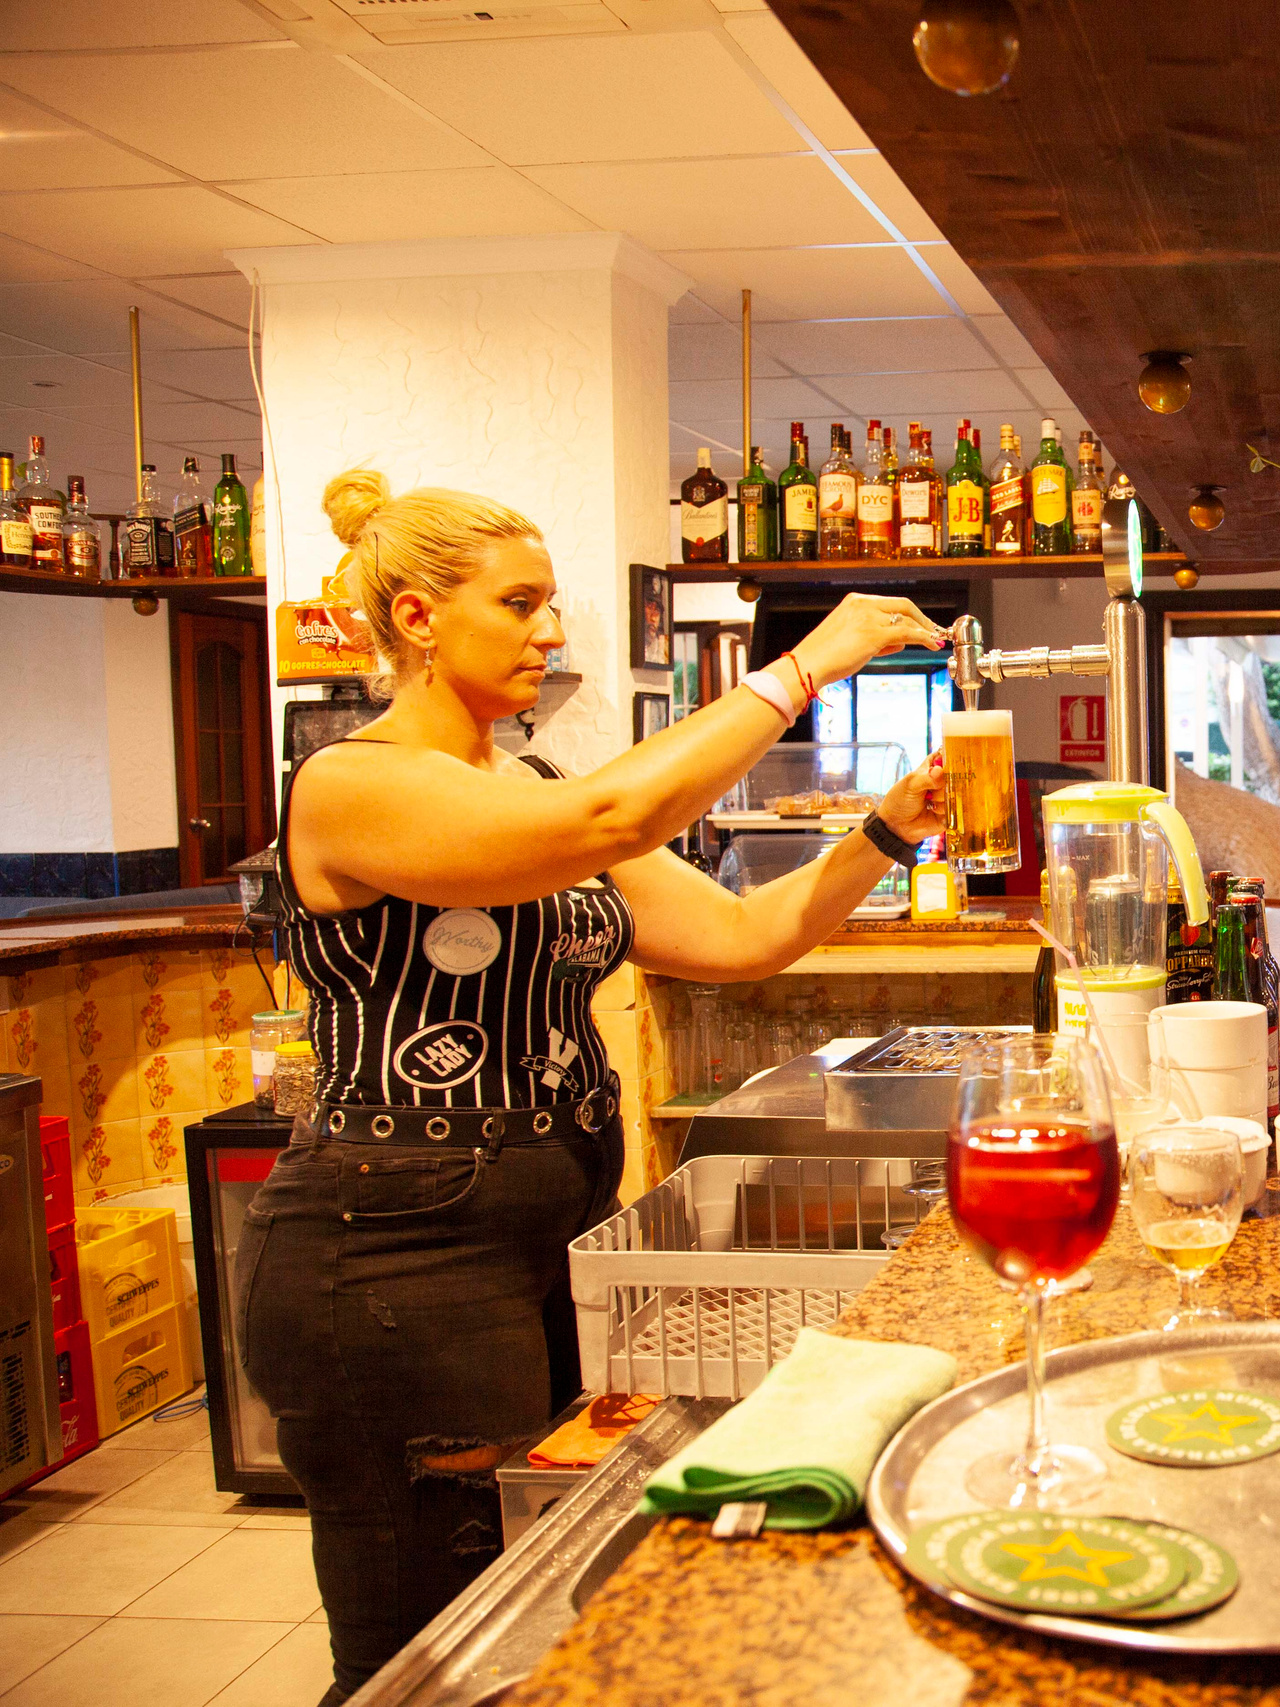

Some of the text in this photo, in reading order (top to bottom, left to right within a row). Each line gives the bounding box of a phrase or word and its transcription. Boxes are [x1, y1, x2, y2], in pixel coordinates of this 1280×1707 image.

[791, 488, 817, 498] JAMES
[861, 494, 889, 506] DYC
[992, 486, 1022, 500] RED LABEL
[35, 511, 62, 520] SOUTHE
[38, 519, 63, 530] COMFO
[295, 620, 339, 639] Gofres
[309, 636, 337, 645] chocolate
[279, 659, 366, 673] 10 GOFRES CHOCOLATE
[431, 927, 494, 953] Worthy
[414, 1033, 460, 1066] LAZY
[429, 1043, 473, 1077] LADY
[544, 1059, 567, 1077] Victory
[117, 1278, 160, 1305] SCHWEPPES
[127, 1367, 169, 1398] SCHWEPPES
